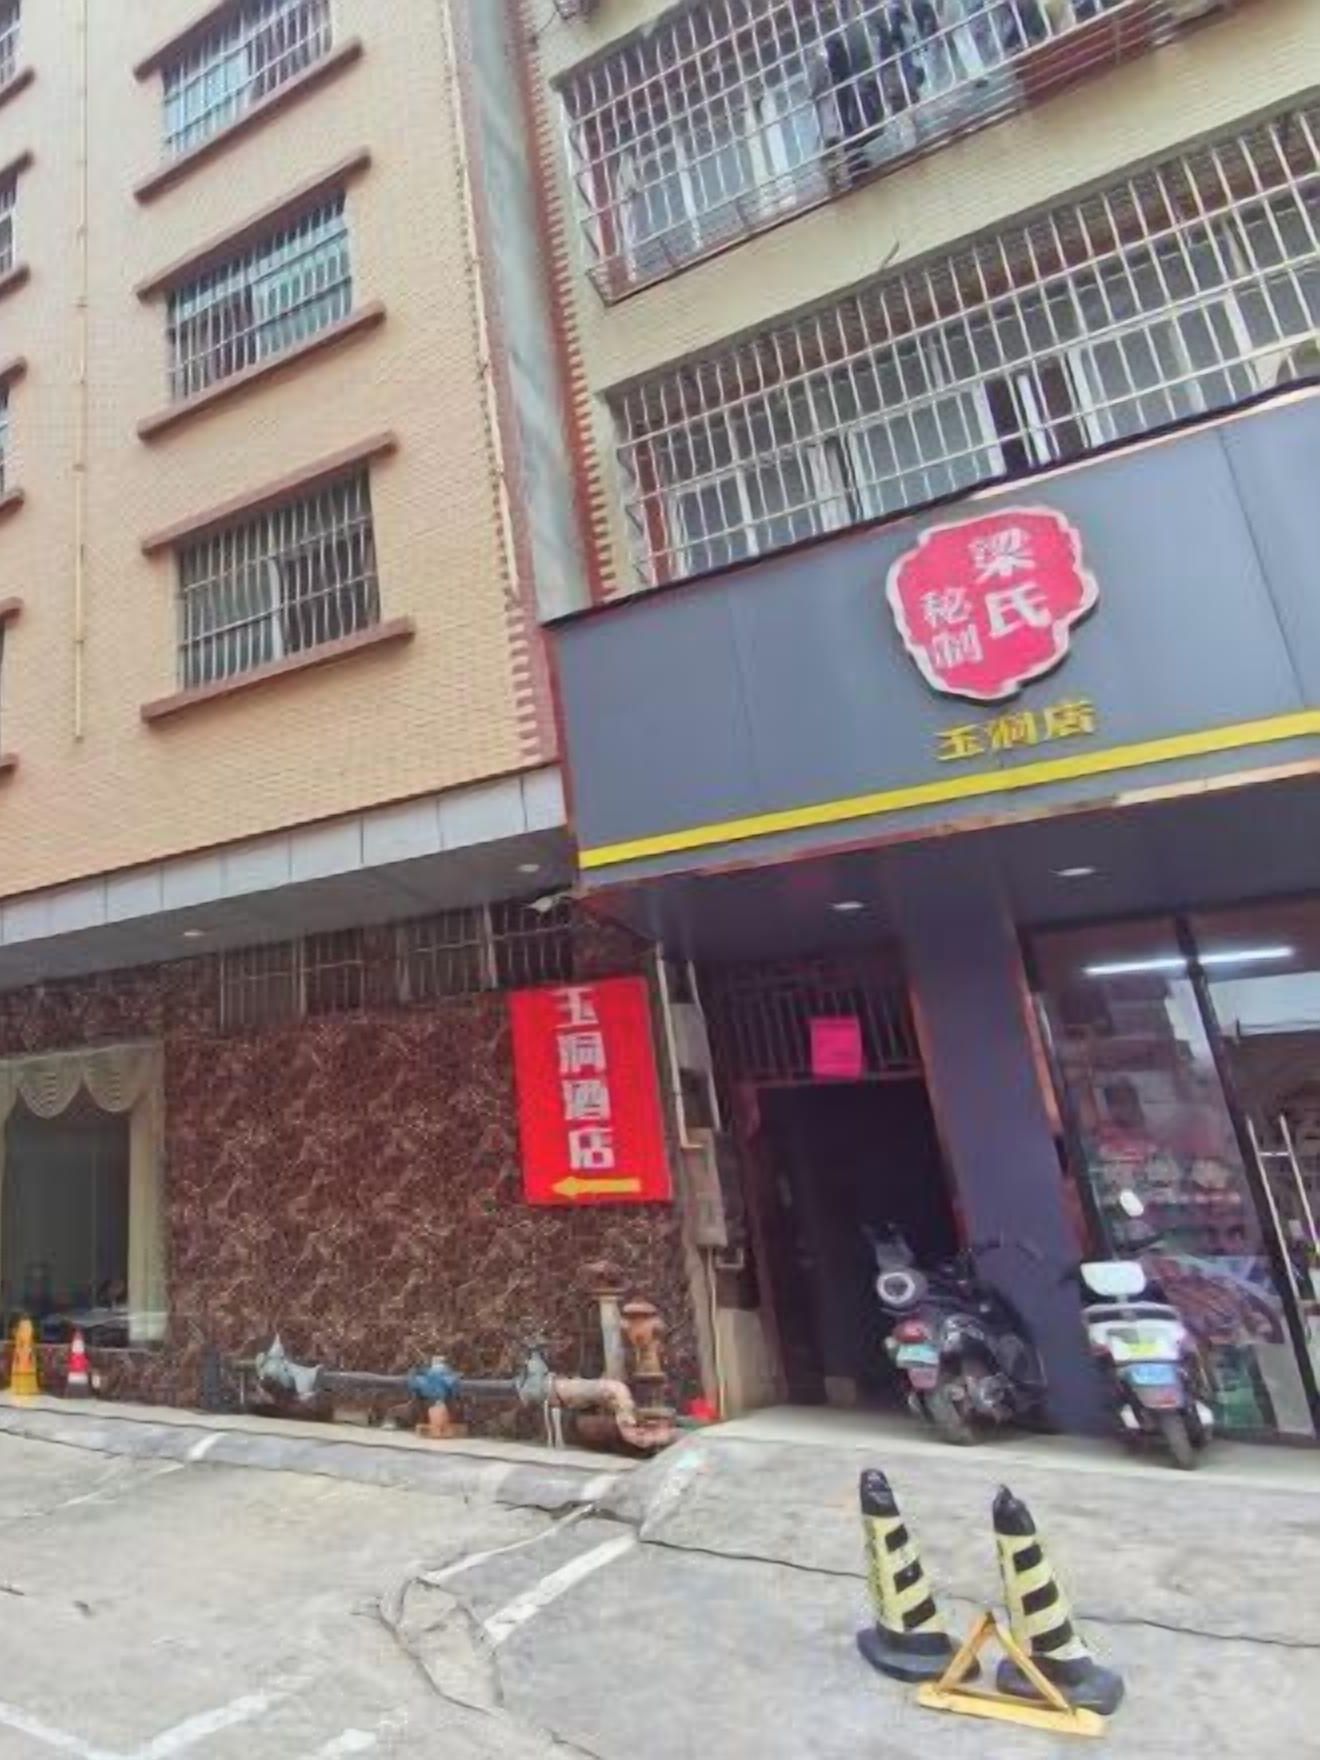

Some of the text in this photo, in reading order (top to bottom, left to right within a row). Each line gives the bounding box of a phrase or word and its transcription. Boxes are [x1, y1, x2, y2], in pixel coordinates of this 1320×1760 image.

[968, 526, 1053, 640] 梁氏
[553, 986, 616, 1170] 玉洞酒店
